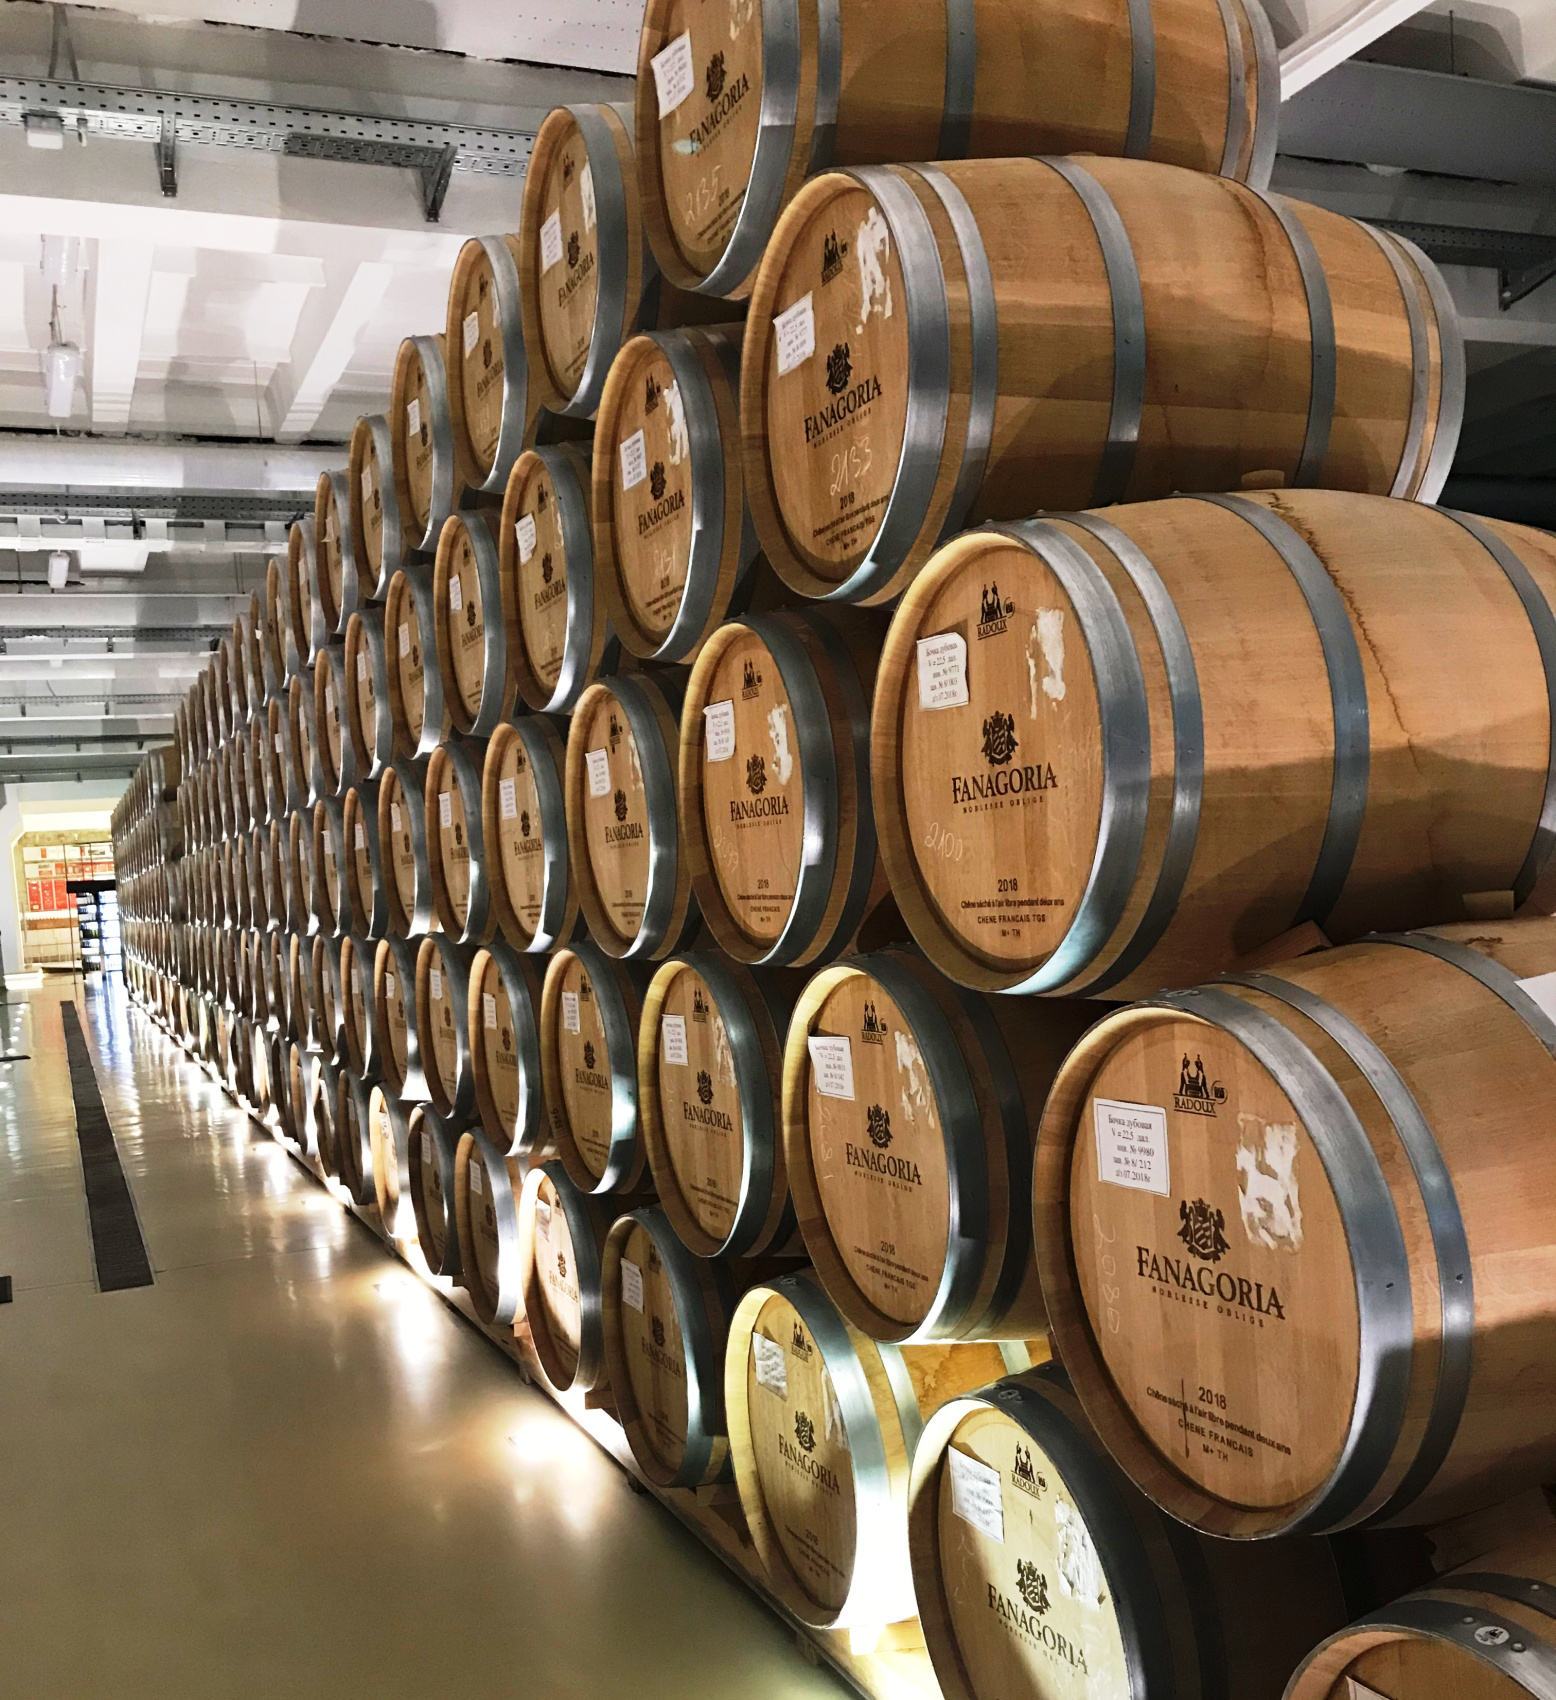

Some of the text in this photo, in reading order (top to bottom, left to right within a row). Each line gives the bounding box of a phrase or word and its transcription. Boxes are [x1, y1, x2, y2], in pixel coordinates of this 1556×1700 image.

[689, 73, 749, 155] FANAGORIA
[804, 375, 882, 443] FANAGORIA
[638, 489, 684, 535] FANAGORIA
[840, 492, 855, 510] 2018
[978, 619, 1007, 637] RADOUX
[952, 762, 1058, 804] FANAGORIA
[730, 795, 789, 821] FANAGORIA
[963, 796, 1043, 813] NOBLESSE OBLIGE
[605, 822, 643, 843] FANAGORIA
[758, 879, 769, 889] 2018
[998, 878, 1018, 892] 2018
[961, 900, 976, 909] Chêne
[1005, 899, 1017, 907] libre
[1017, 899, 1038, 908] pendant
[1040, 898, 1052, 906] deux
[978, 914, 1046, 924] CHENE FRANCAIS TGS
[862, 1032, 883, 1042] RADOUX
[575, 1067, 608, 1090] FANAGORIA
[684, 1102, 733, 1132] FANAGORIA
[1174, 1097, 1216, 1114] RADOUX
[1108, 1114, 1152, 1130] Бочка дубовая
[1130, 1145, 1137, 1153] №
[1138, 1147, 1154, 1157] 9980
[846, 1142, 922, 1185] FANAGORIA
[1124, 1158, 1130, 1166] №
[1139, 1160, 1152, 1170] 212
[880, 1240, 895, 1256] 2018
[1136, 1246, 1285, 1320] FANAGORIA
[1152, 1286, 1264, 1327] NOBLESSE OBLIGE
[642, 1336, 680, 1378] FANAGORIA
[1199, 1386, 1227, 1409] 2018
[1147, 1387, 1167, 1403] Chêne
[1208, 1411, 1224, 1426] libre
[1225, 1419, 1255, 1441] pendant
[1256, 1433, 1275, 1449] deux
[1276, 1441, 1291, 1456] ans
[1178, 1418, 1253, 1457] CHENE FRANCAIS
[1203, 1443, 1228, 1462] M+ TH
[779, 1434, 840, 1495] FANAGORIA
[1012, 1472, 1040, 1497] RADOUX
[988, 1582, 1089, 1677] FANAGORIA
